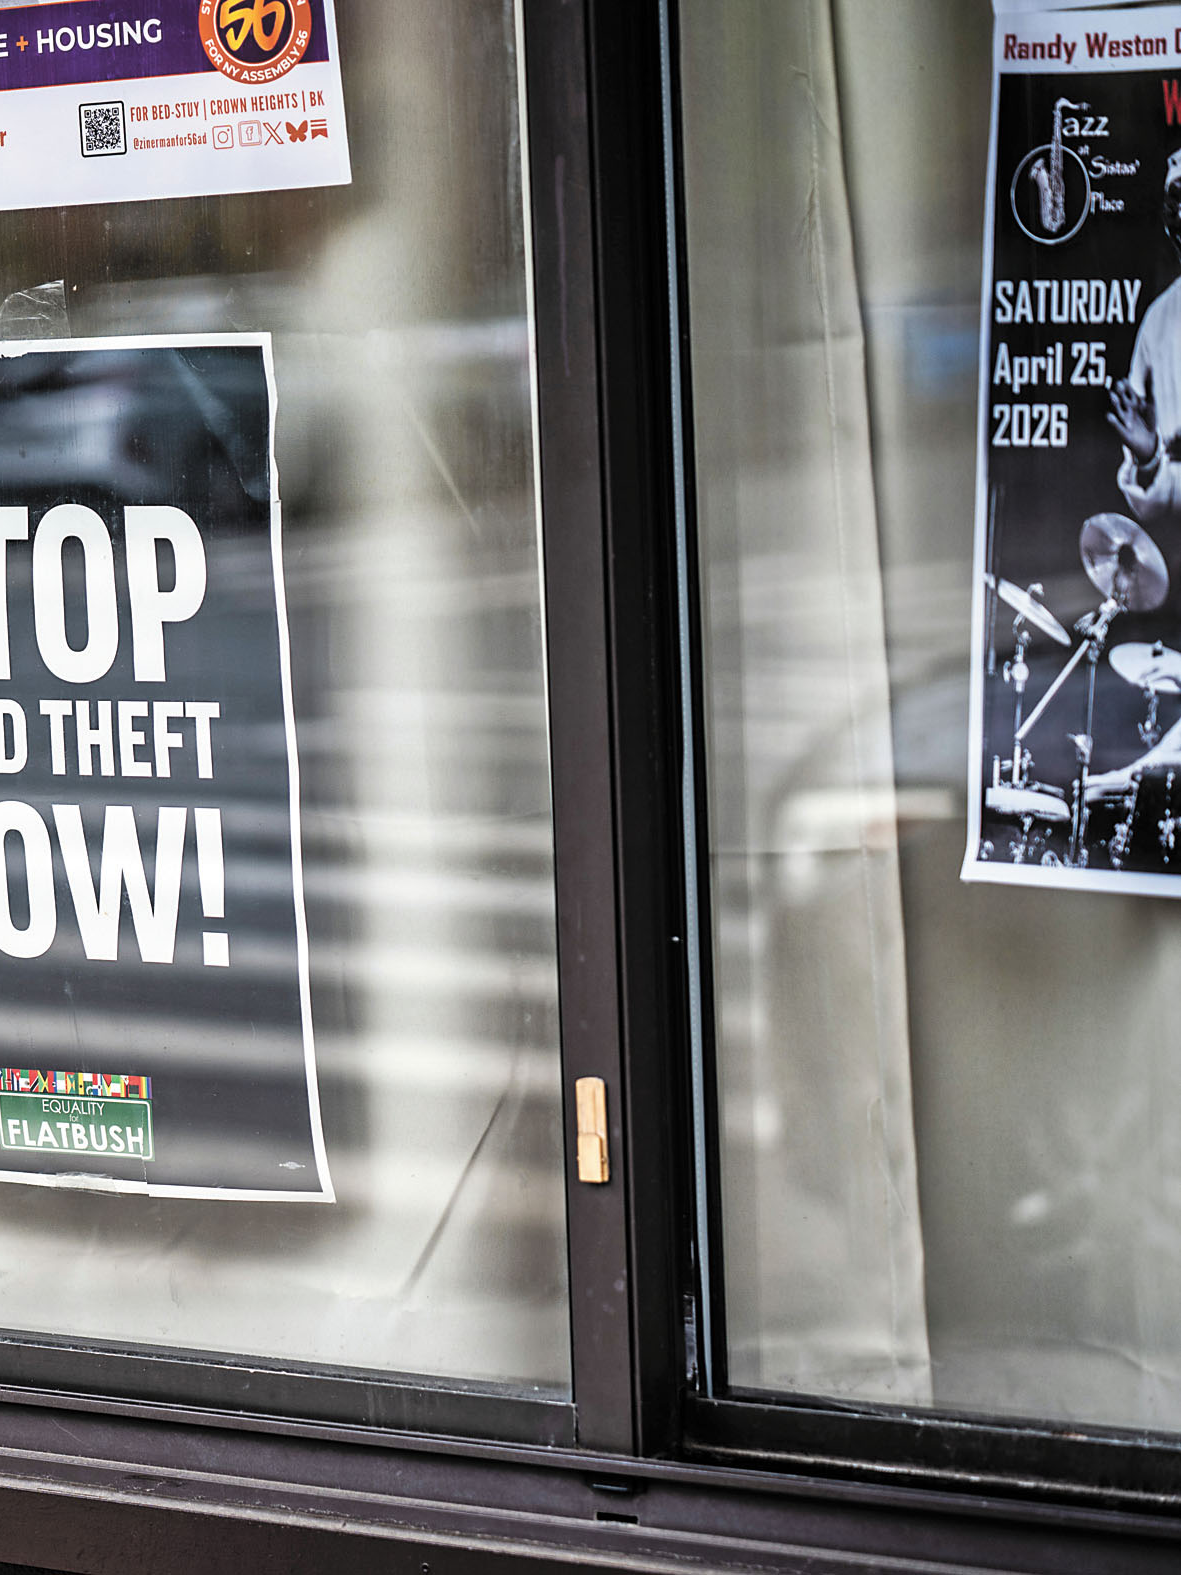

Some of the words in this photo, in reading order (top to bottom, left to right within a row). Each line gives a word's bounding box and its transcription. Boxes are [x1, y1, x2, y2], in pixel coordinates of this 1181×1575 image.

[16, 35, 29, 51] +
[36, 18, 162, 54] HOUSING
[220, 0, 286, 51] 56
[205, 38, 224, 66] FOR
[222, 61, 240, 77] NY
[240, 46, 301, 81] ASSEMBLY
[295, 30, 308, 47] 56
[1003, 33, 1077, 65] Randy
[1085, 32, 1167, 59] Weston
[130, 106, 148, 122] FOR
[152, 101, 200, 120] BED-STUY
[210, 97, 247, 116] CROWN
[251, 93, 298, 111] HEIGHTS
[309, 90, 325, 107] BK
[133, 132, 207, 150] @zinermanfor56ad
[994, 279, 1141, 324] SATURDAY
[993, 341, 1063, 395] April
[1070, 341, 1112, 390] 25,
[992, 403, 1069, 447] 2026
[39, 699, 221, 779] THEFT
[42, 1099, 105, 1116] EQUALITY
[69, 1113, 79, 1123] for
[7, 1118, 144, 1154] FLATBUSH
